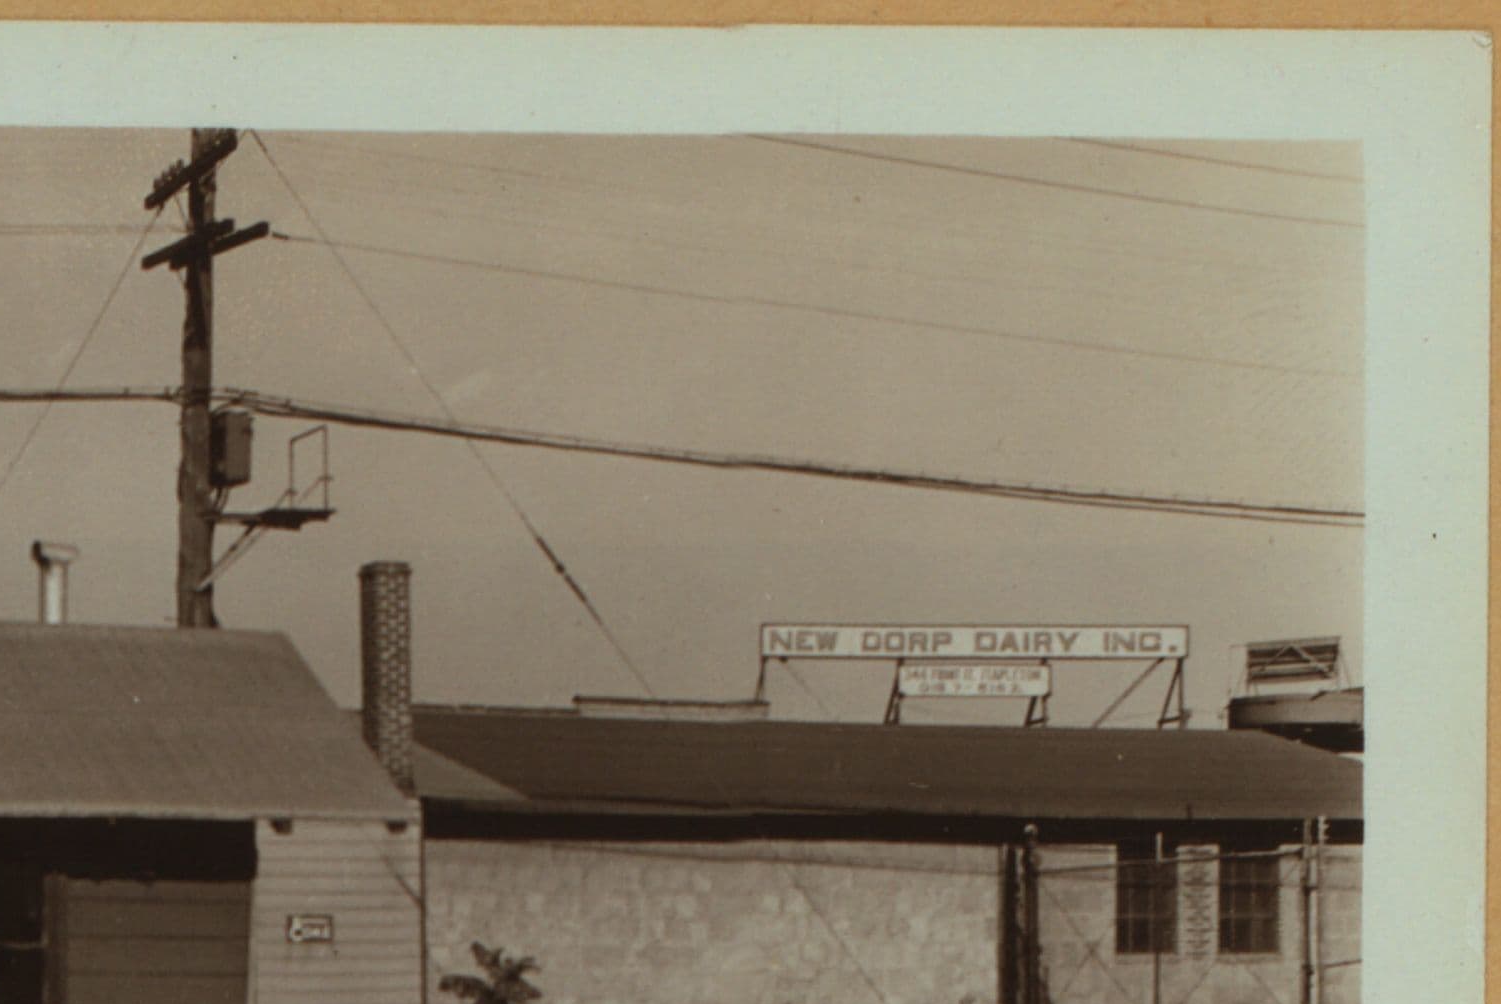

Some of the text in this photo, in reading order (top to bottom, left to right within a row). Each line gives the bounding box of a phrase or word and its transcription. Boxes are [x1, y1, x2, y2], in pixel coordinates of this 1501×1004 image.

[769, 630, 1178, 653] NEW DORP DAIRY INC.
